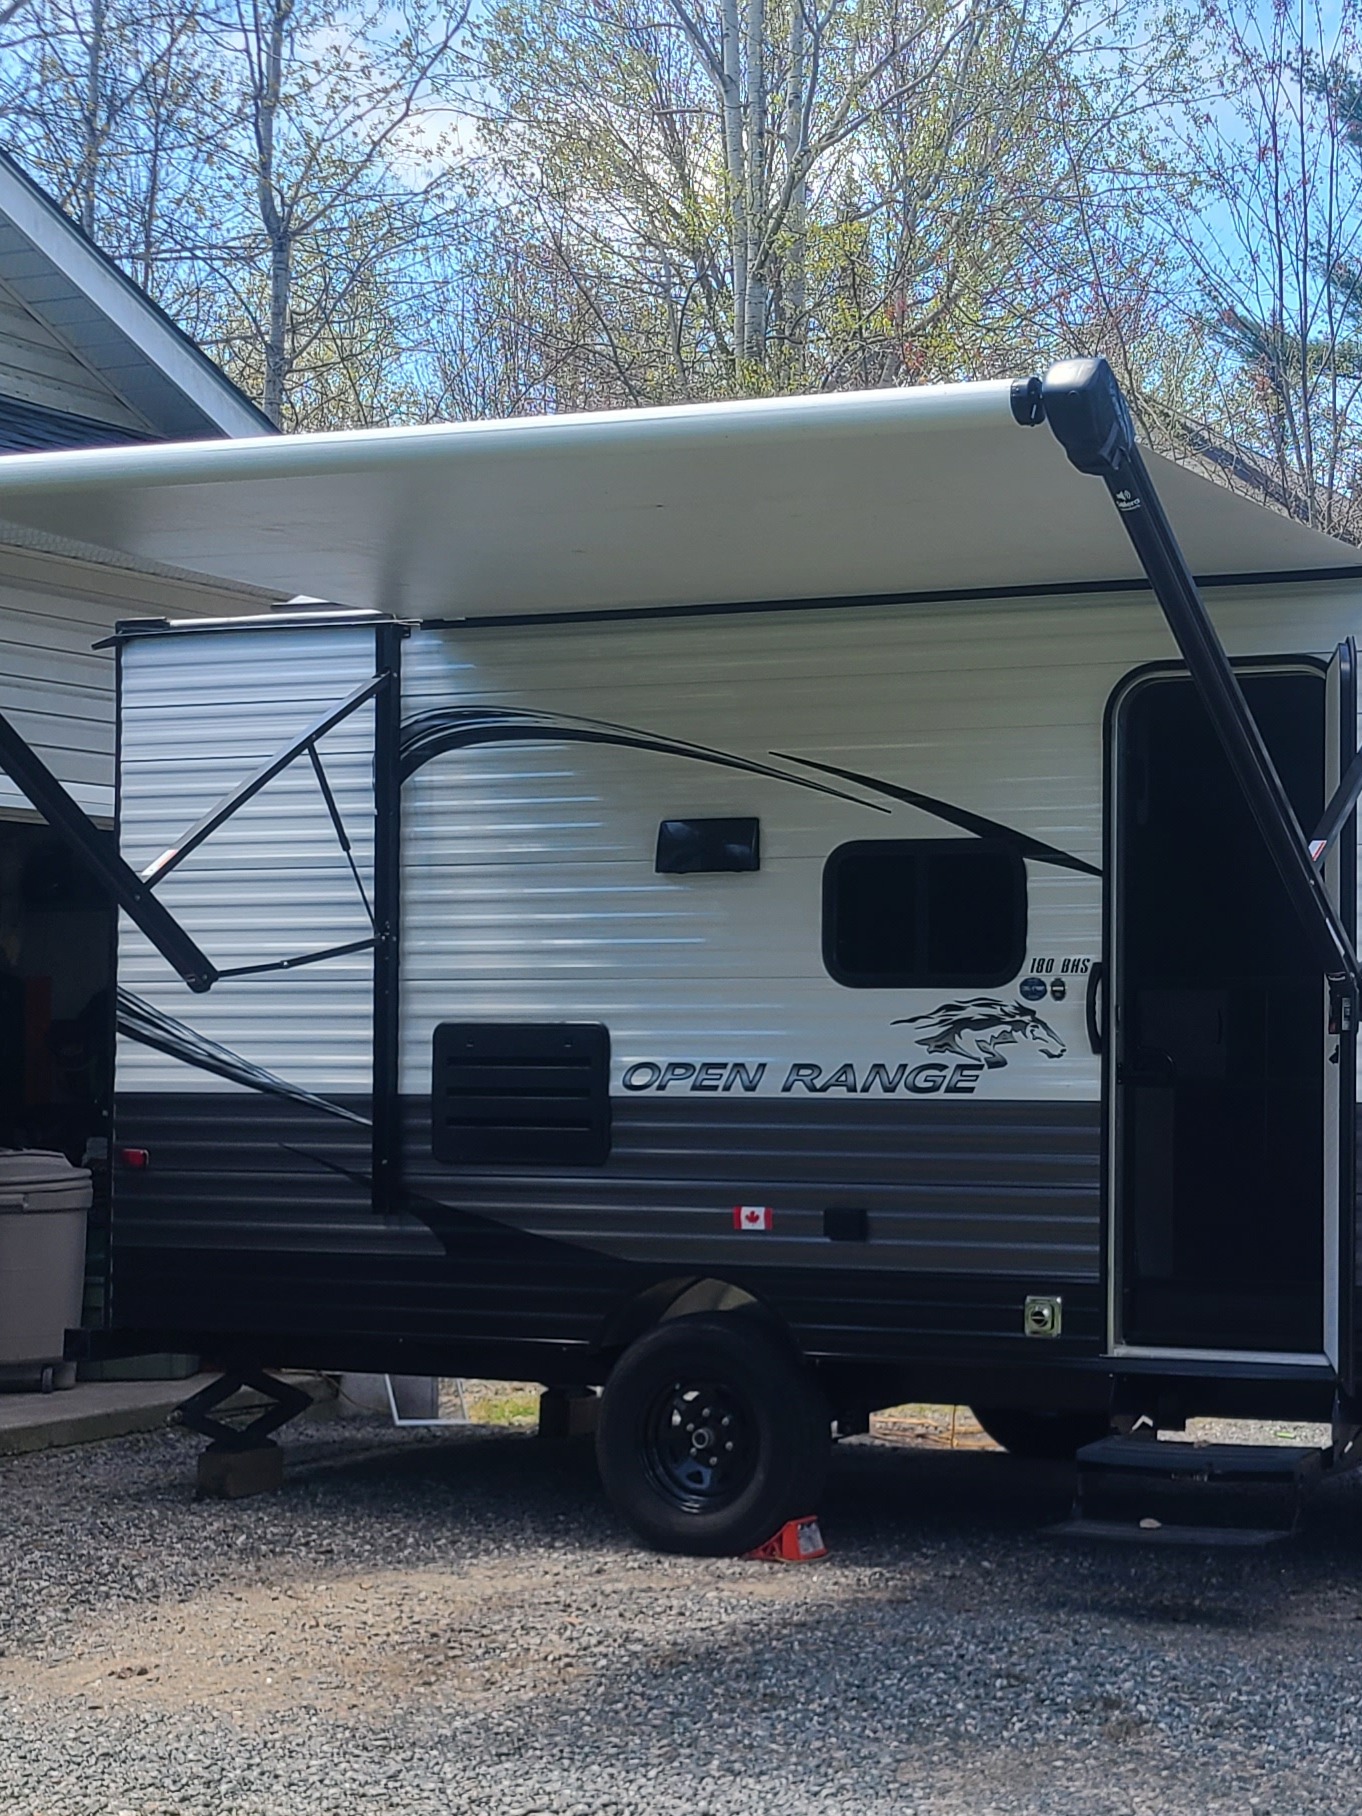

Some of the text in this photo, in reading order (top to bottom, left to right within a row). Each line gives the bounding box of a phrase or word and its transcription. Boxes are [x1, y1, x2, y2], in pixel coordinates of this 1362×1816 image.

[1029, 958, 1091, 974] 180 BHS
[622, 1061, 985, 1094] OPEN RANGE
